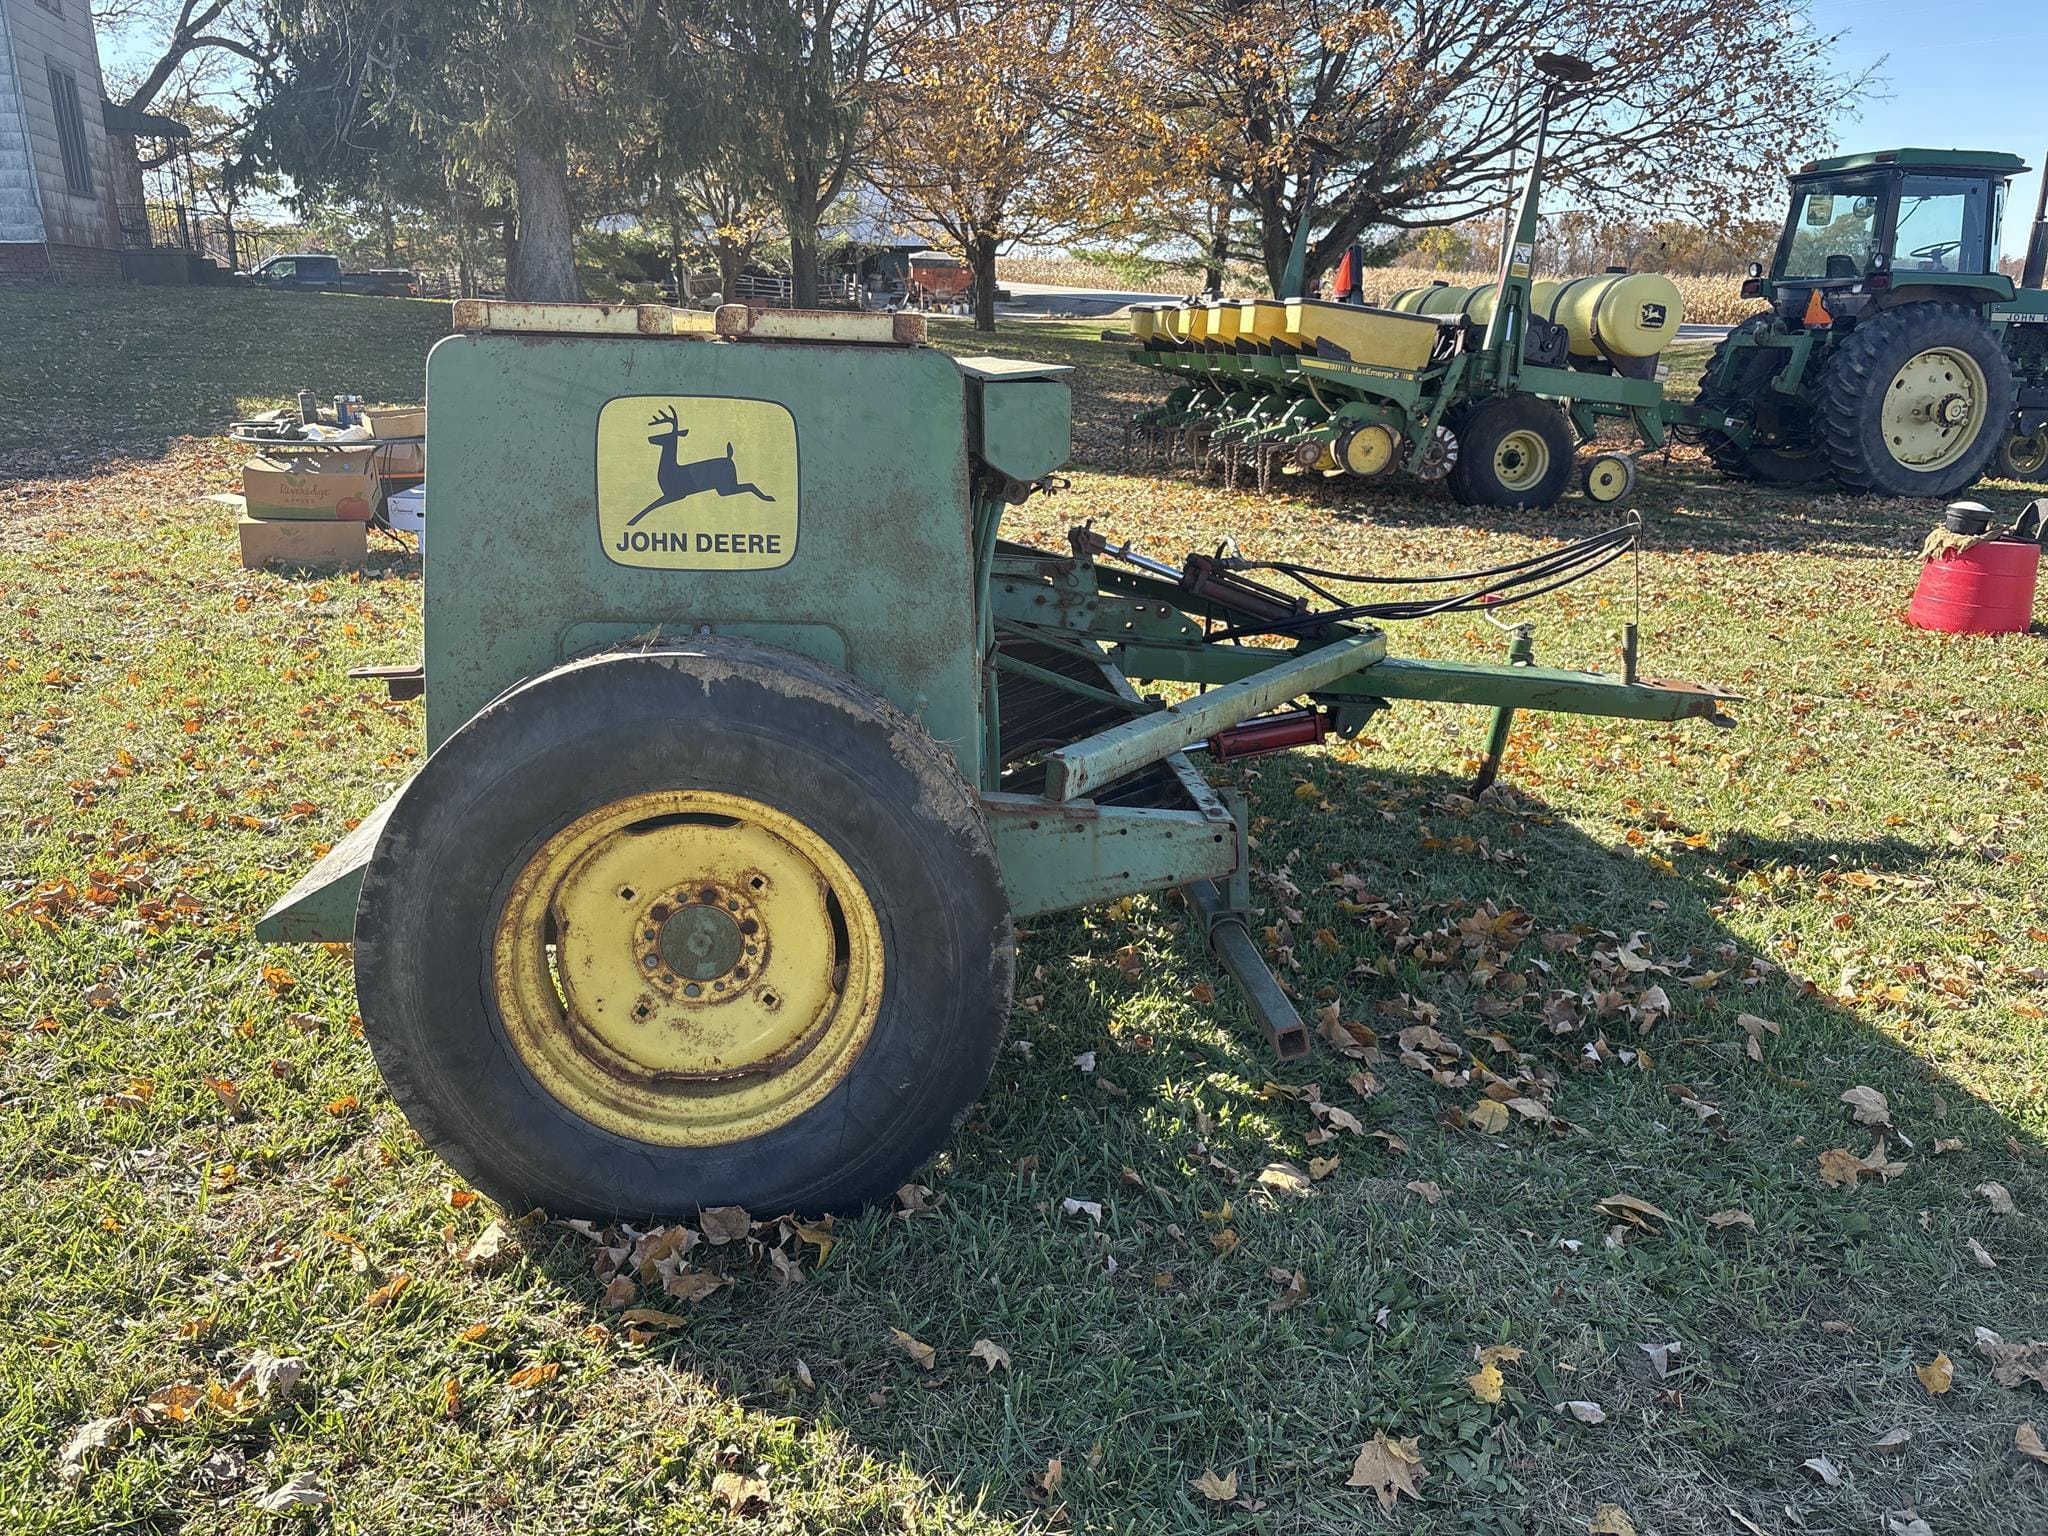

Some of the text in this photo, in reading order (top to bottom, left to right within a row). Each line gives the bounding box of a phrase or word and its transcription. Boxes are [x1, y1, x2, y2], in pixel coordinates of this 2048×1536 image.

[2007, 313, 2035, 322] JOHN
[1350, 366, 1399, 379] MaxEmerge 2
[280, 483, 330, 499] Riveridge
[616, 531, 781, 554] JOHN DEERE
